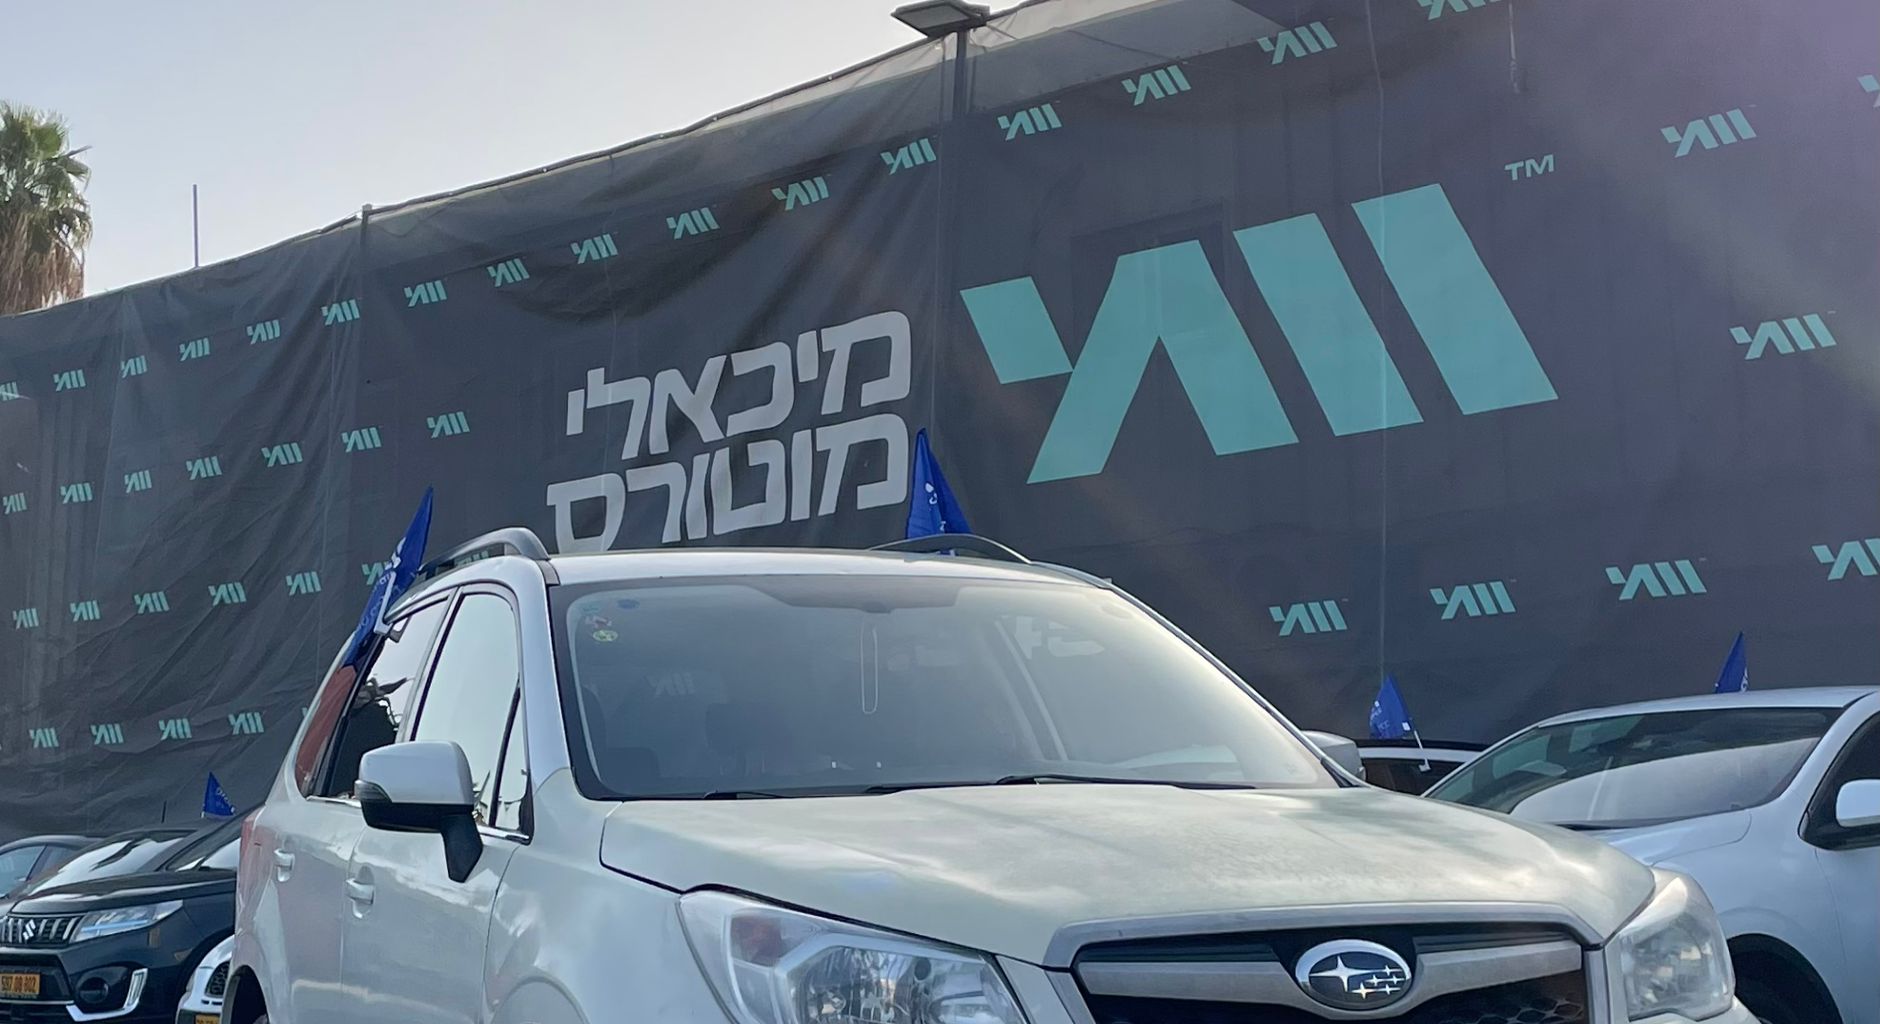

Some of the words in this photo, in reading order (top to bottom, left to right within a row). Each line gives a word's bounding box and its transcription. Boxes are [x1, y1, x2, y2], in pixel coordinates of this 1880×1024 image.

[1504, 154, 1554, 180] TM
[567, 311, 911, 460] מיכאלי
[547, 413, 909, 553] מוטורס
